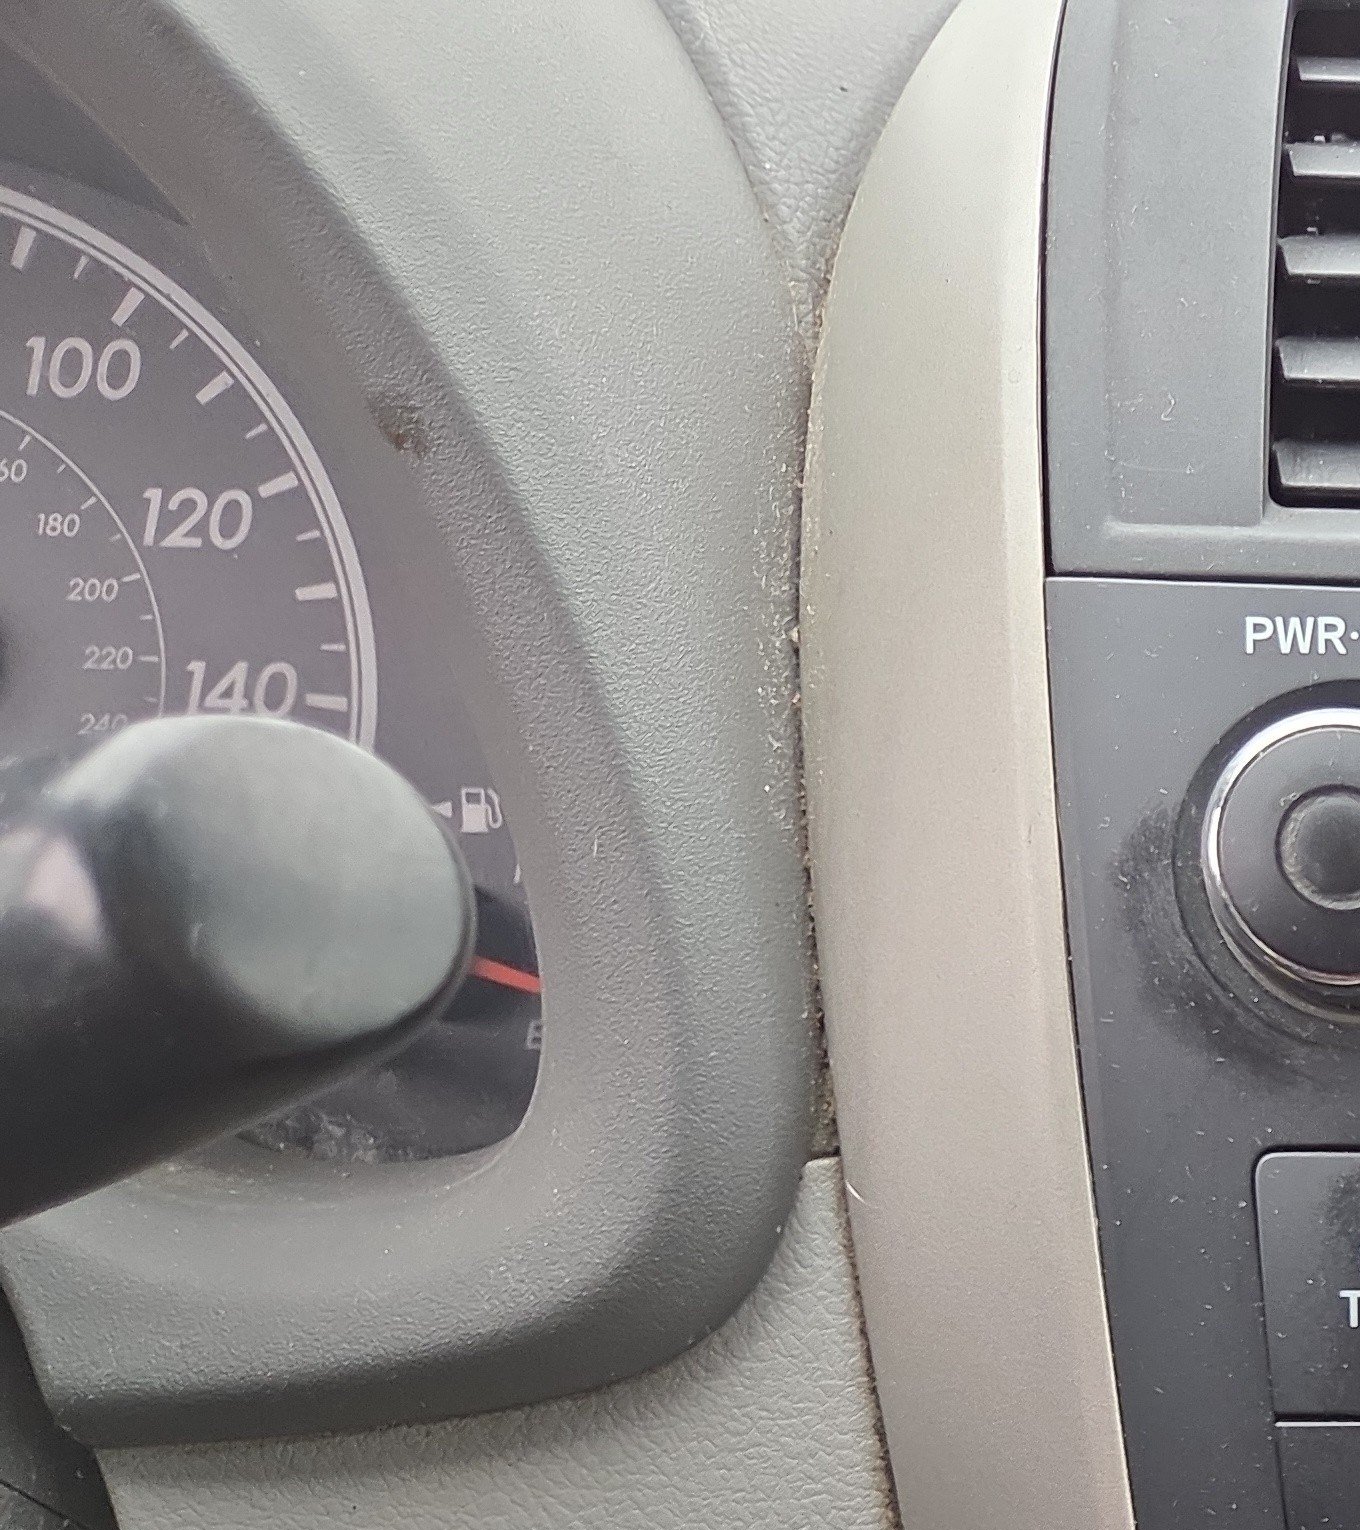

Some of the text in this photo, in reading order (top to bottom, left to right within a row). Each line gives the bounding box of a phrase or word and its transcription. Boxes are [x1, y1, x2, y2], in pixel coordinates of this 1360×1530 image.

[25, 336, 142, 400] 100
[37, 512, 81, 538] 180
[142, 486, 254, 550] 120
[67, 577, 119, 602] 200
[82, 645, 134, 671] 220
[185, 660, 298, 716] 140
